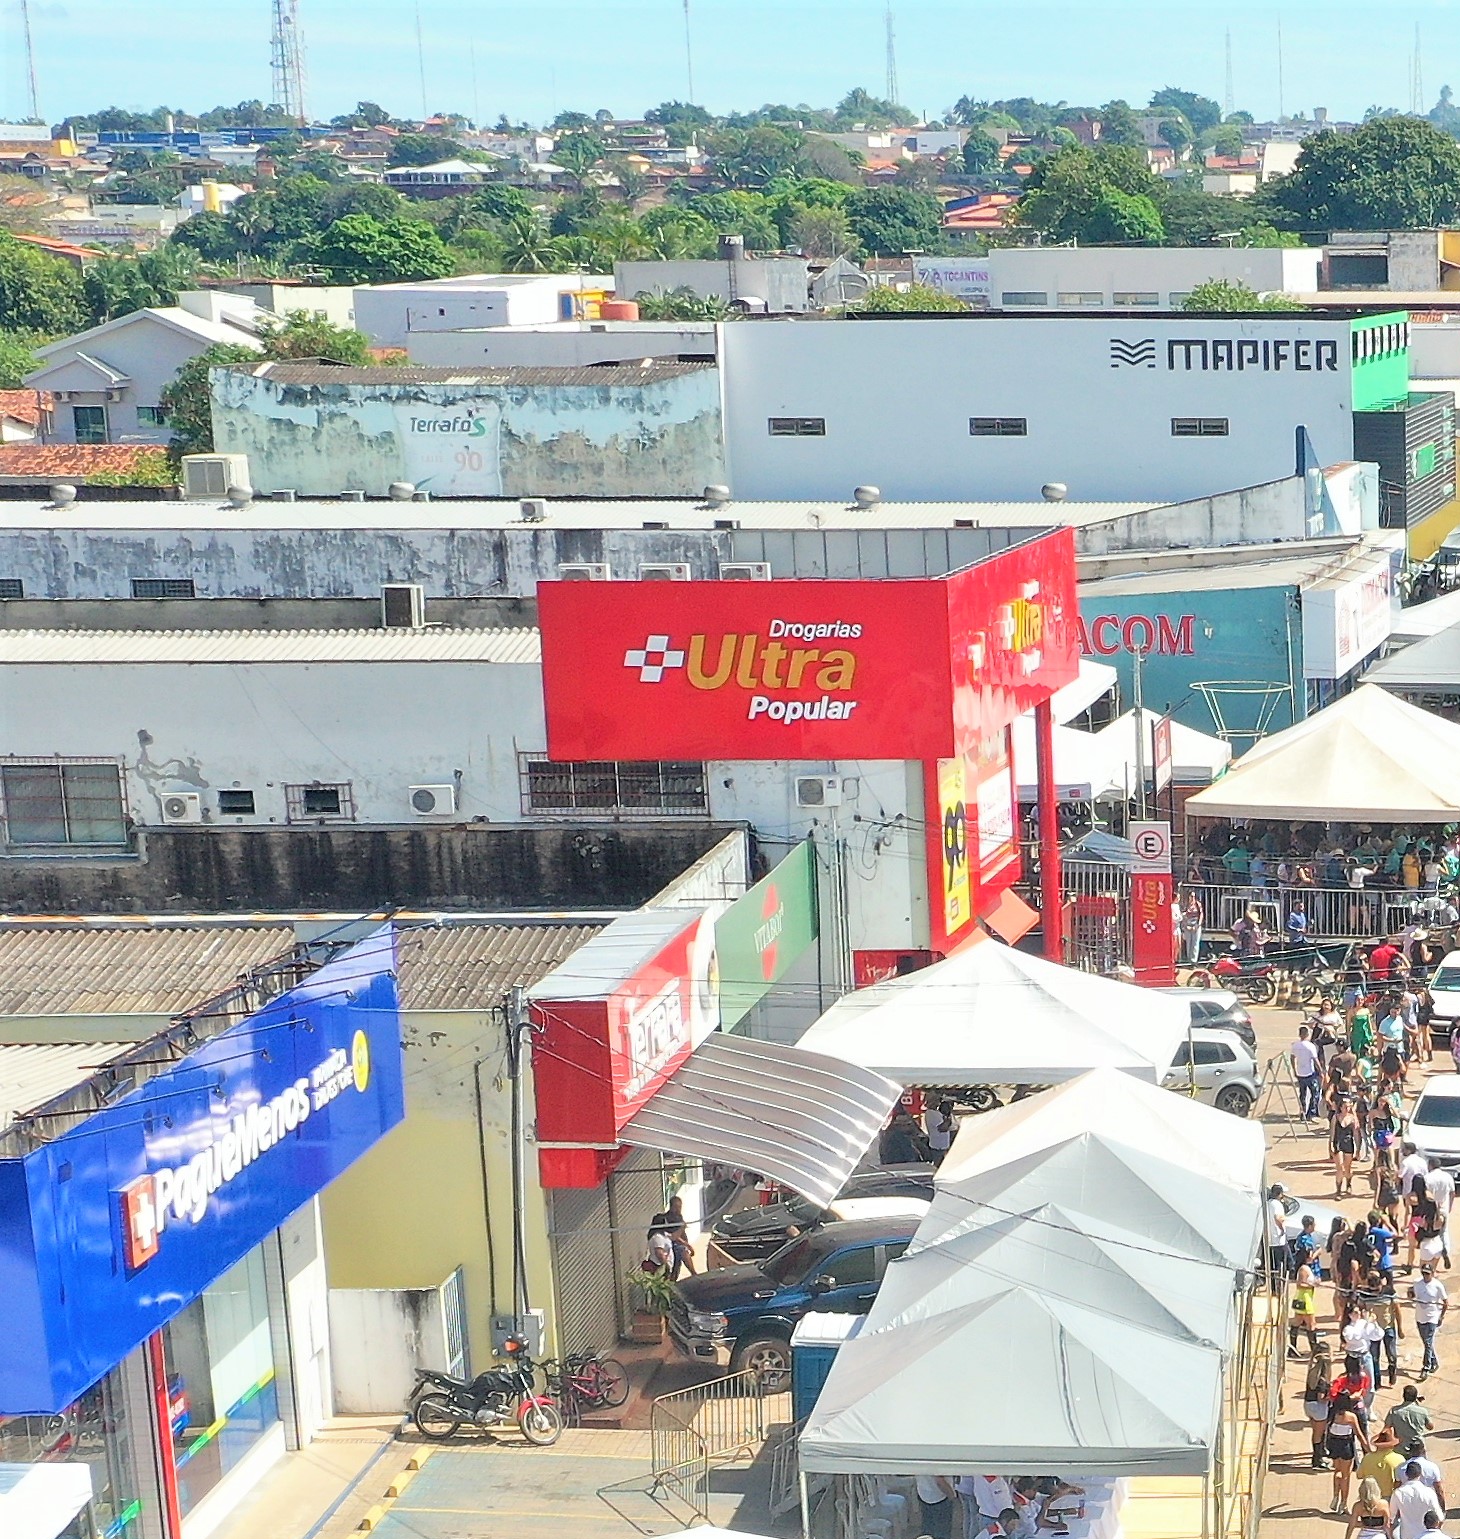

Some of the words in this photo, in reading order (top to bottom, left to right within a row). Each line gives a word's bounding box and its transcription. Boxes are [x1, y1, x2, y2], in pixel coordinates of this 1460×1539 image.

[1167, 339, 1338, 371] MAPIFER
[769, 619, 862, 642] Drogarias
[686, 633, 858, 691] Ultra
[748, 695, 857, 725] Popular
[1144, 837, 1156, 853] E
[1143, 880, 1158, 920] Ultra
